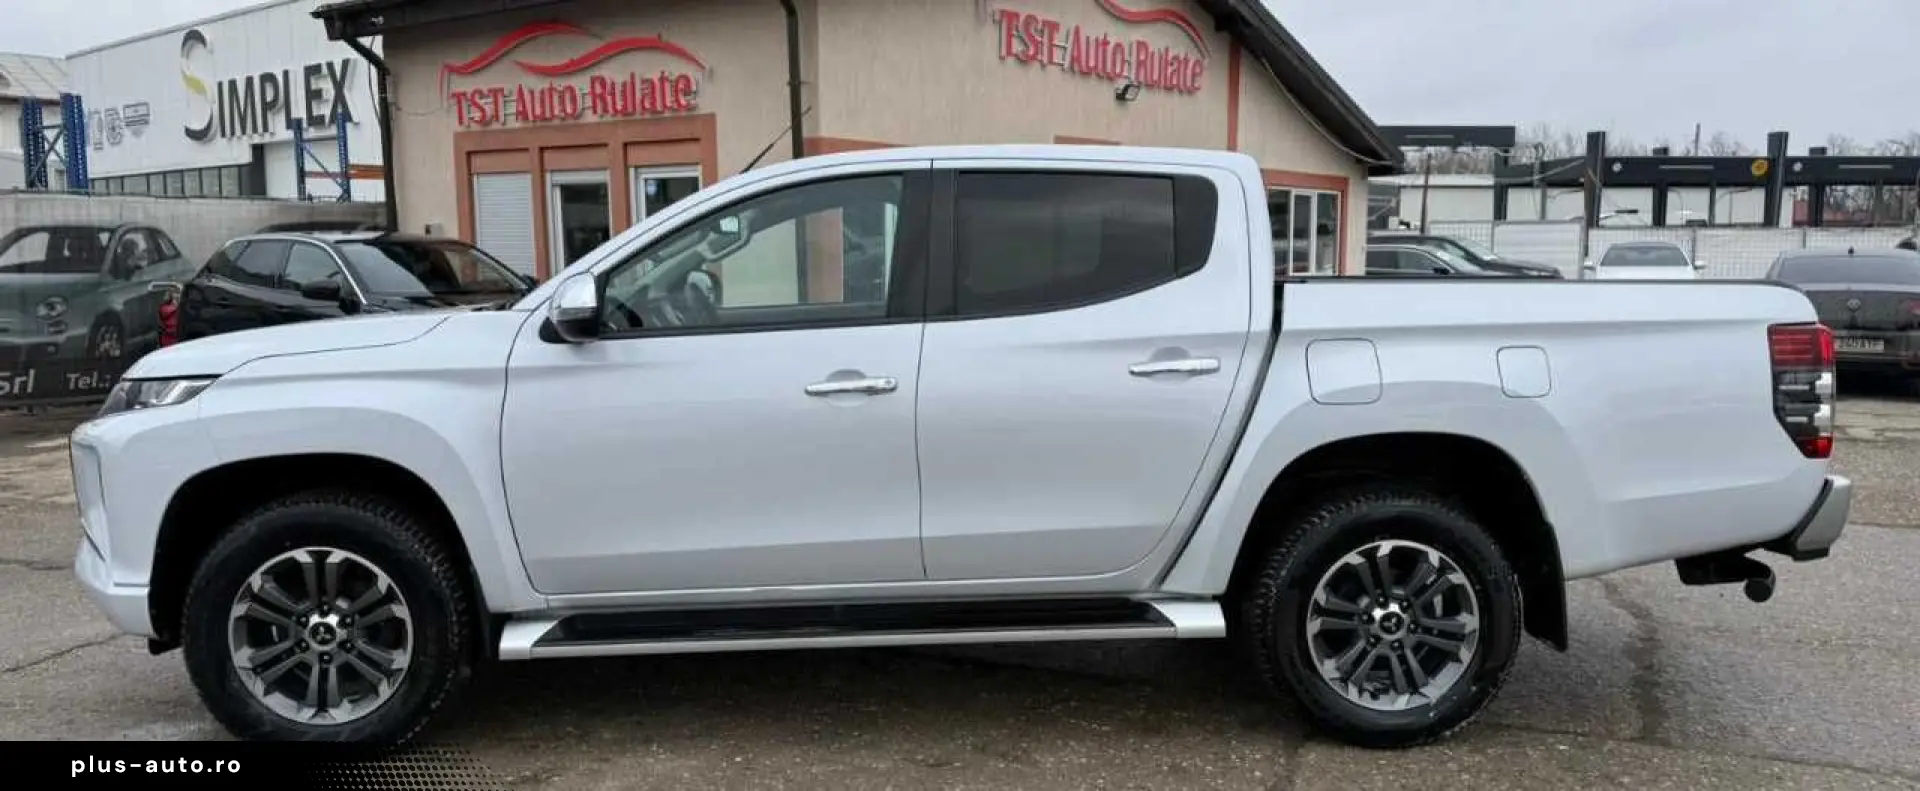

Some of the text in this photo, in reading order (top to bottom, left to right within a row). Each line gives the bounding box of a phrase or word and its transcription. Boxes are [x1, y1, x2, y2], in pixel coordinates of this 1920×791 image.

[181, 29, 355, 141] SIMPLEX
[998, 9, 1204, 93] TST Auto Rulate
[451, 70, 694, 126] TST Auto Rulate
